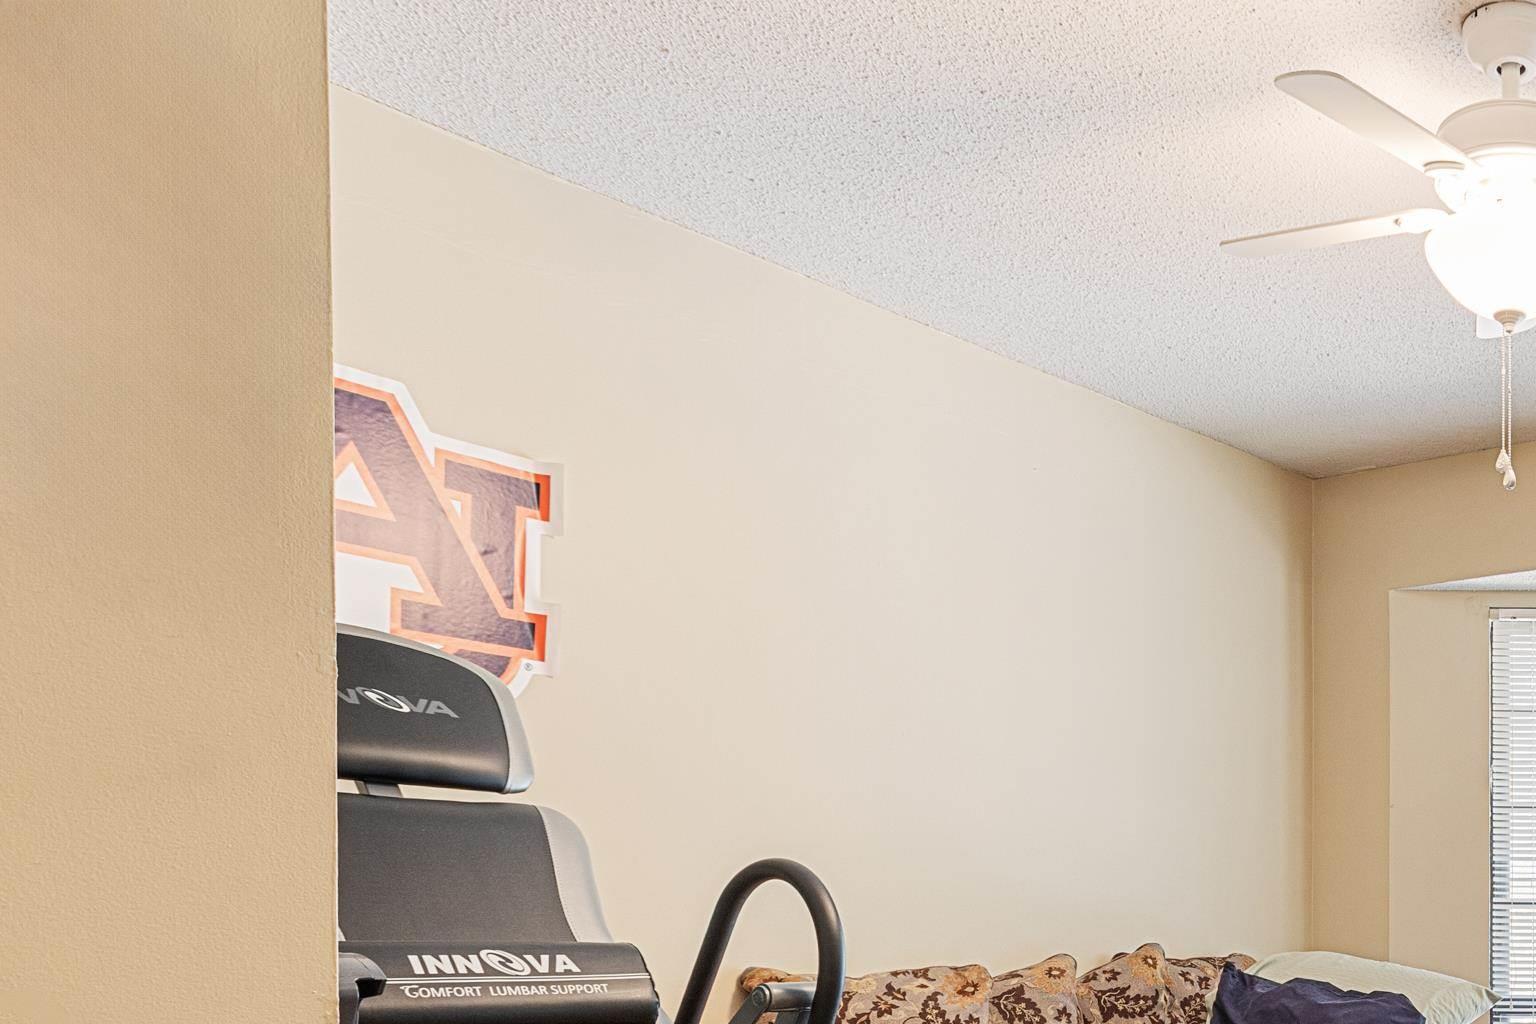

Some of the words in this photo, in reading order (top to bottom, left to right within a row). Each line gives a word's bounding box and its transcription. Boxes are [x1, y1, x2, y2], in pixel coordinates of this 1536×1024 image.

[337, 686, 460, 719] NOVA
[407, 949, 582, 976] INNOVA
[400, 984, 482, 999] COMFORT
[489, 985, 548, 997] LUMBAR
[551, 983, 609, 996] SUPPORT
